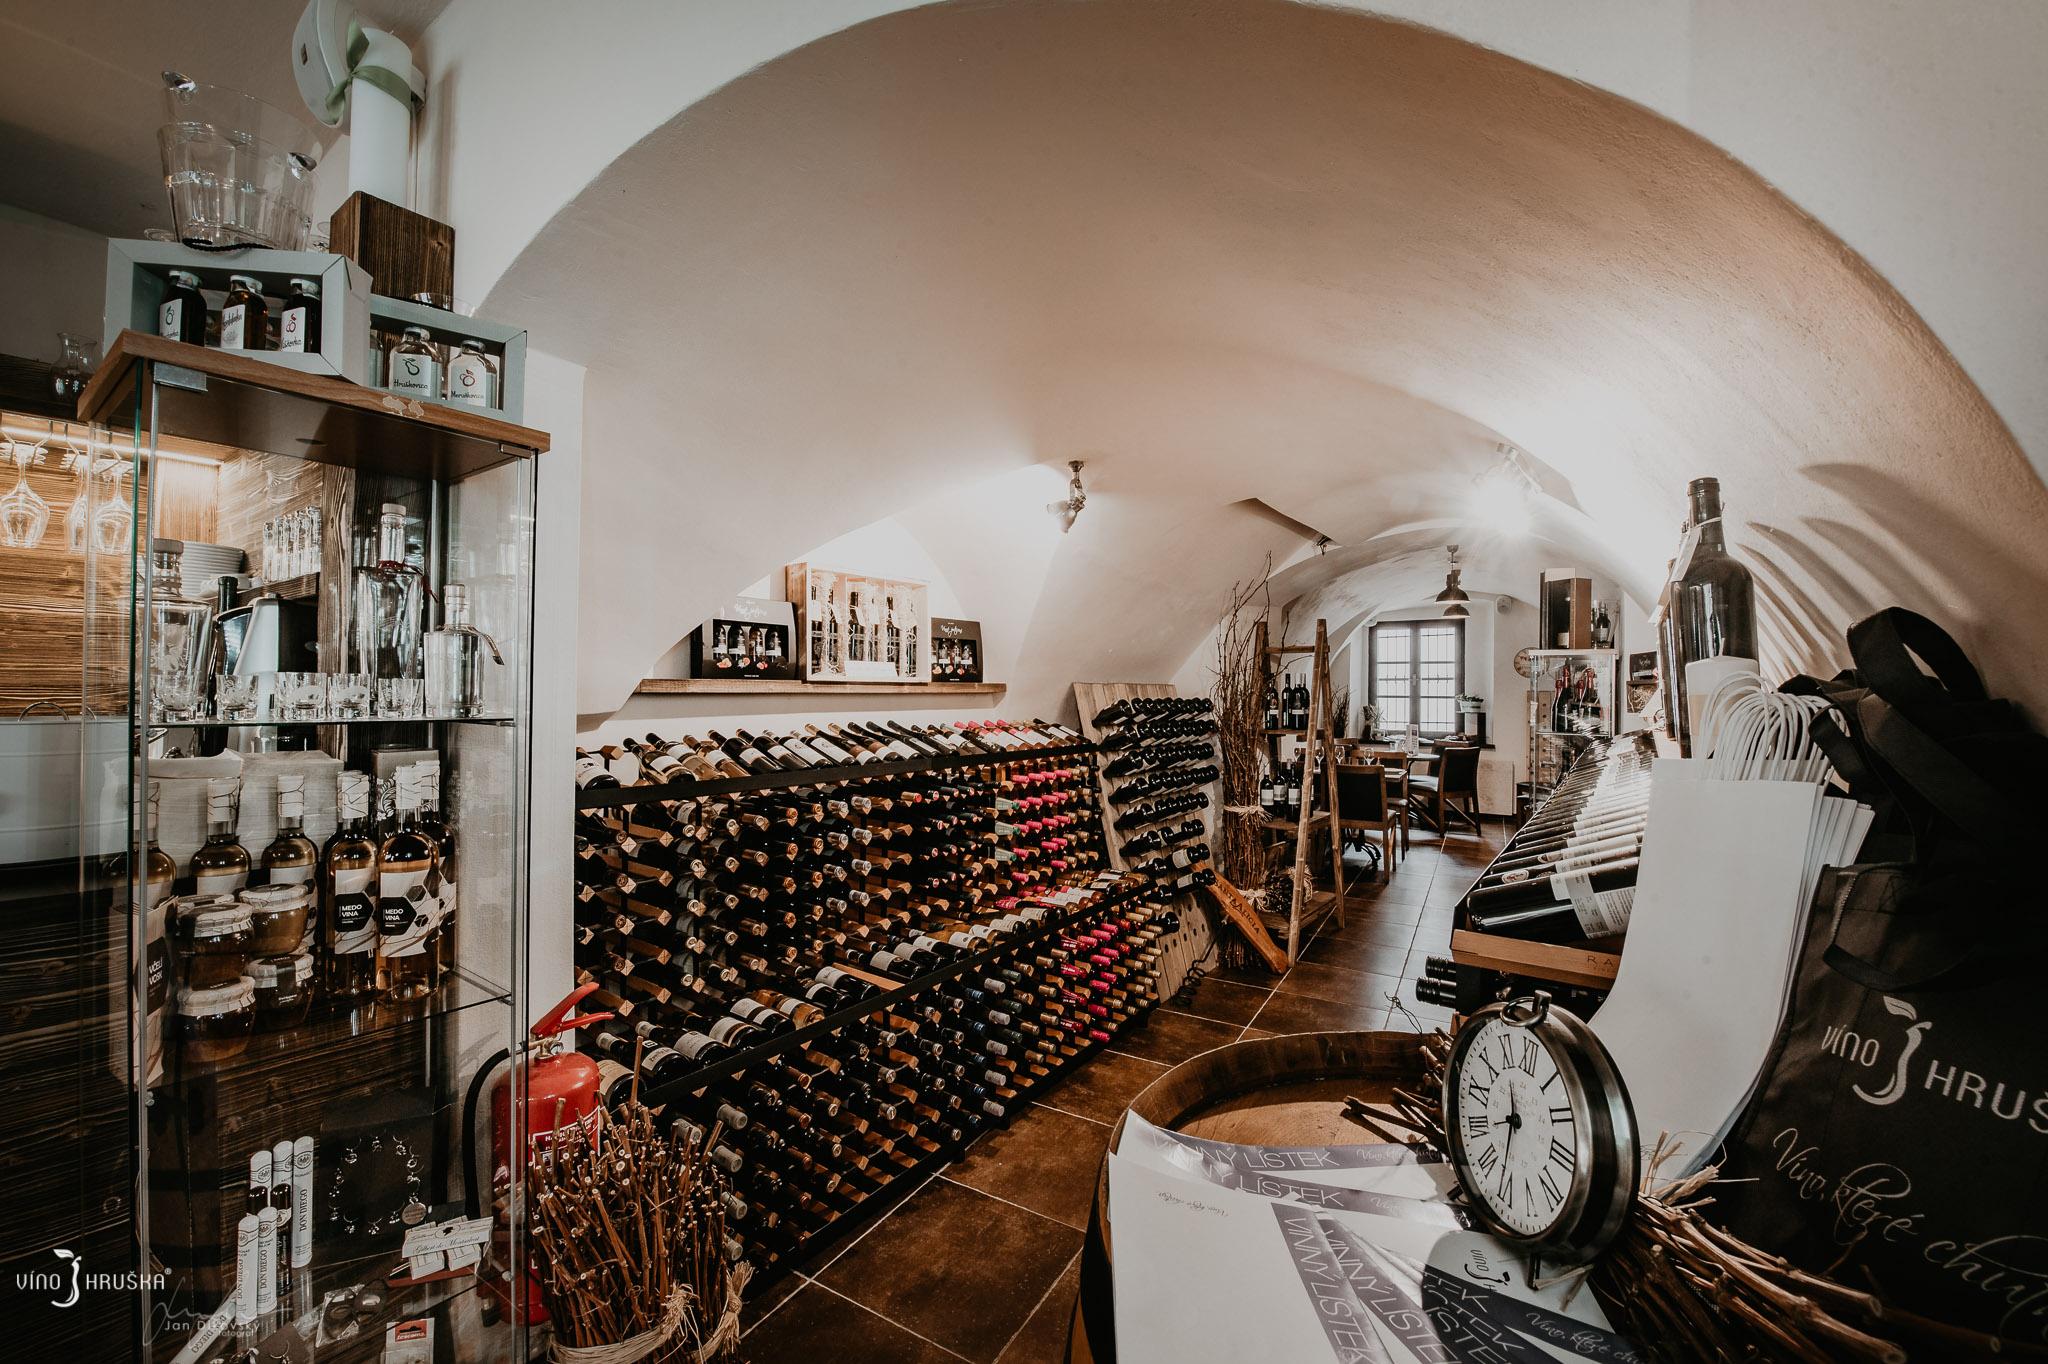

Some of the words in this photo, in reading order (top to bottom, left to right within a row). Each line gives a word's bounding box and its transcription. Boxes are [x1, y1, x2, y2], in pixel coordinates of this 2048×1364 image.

[1498, 1033, 1516, 1070] XI
[1518, 1036, 1539, 1077] XII
[1821, 1024, 1880, 1067] víno
[1478, 1046, 1500, 1085] X
[1539, 1071, 1559, 1095] I
[1468, 1075, 1491, 1109] IX
[1468, 1115, 1489, 1139] VIII
[1549, 1106, 1573, 1126] II
[1243, 1148, 1340, 1168] LÍSTEK
[1478, 1142, 1499, 1179] VII
[1549, 1136, 1575, 1173] III
[300, 1188, 308, 1215] DIEGO
[1284, 1217, 1341, 1282] VINNÝ
[1371, 1298, 1461, 1364] LÍSTE
